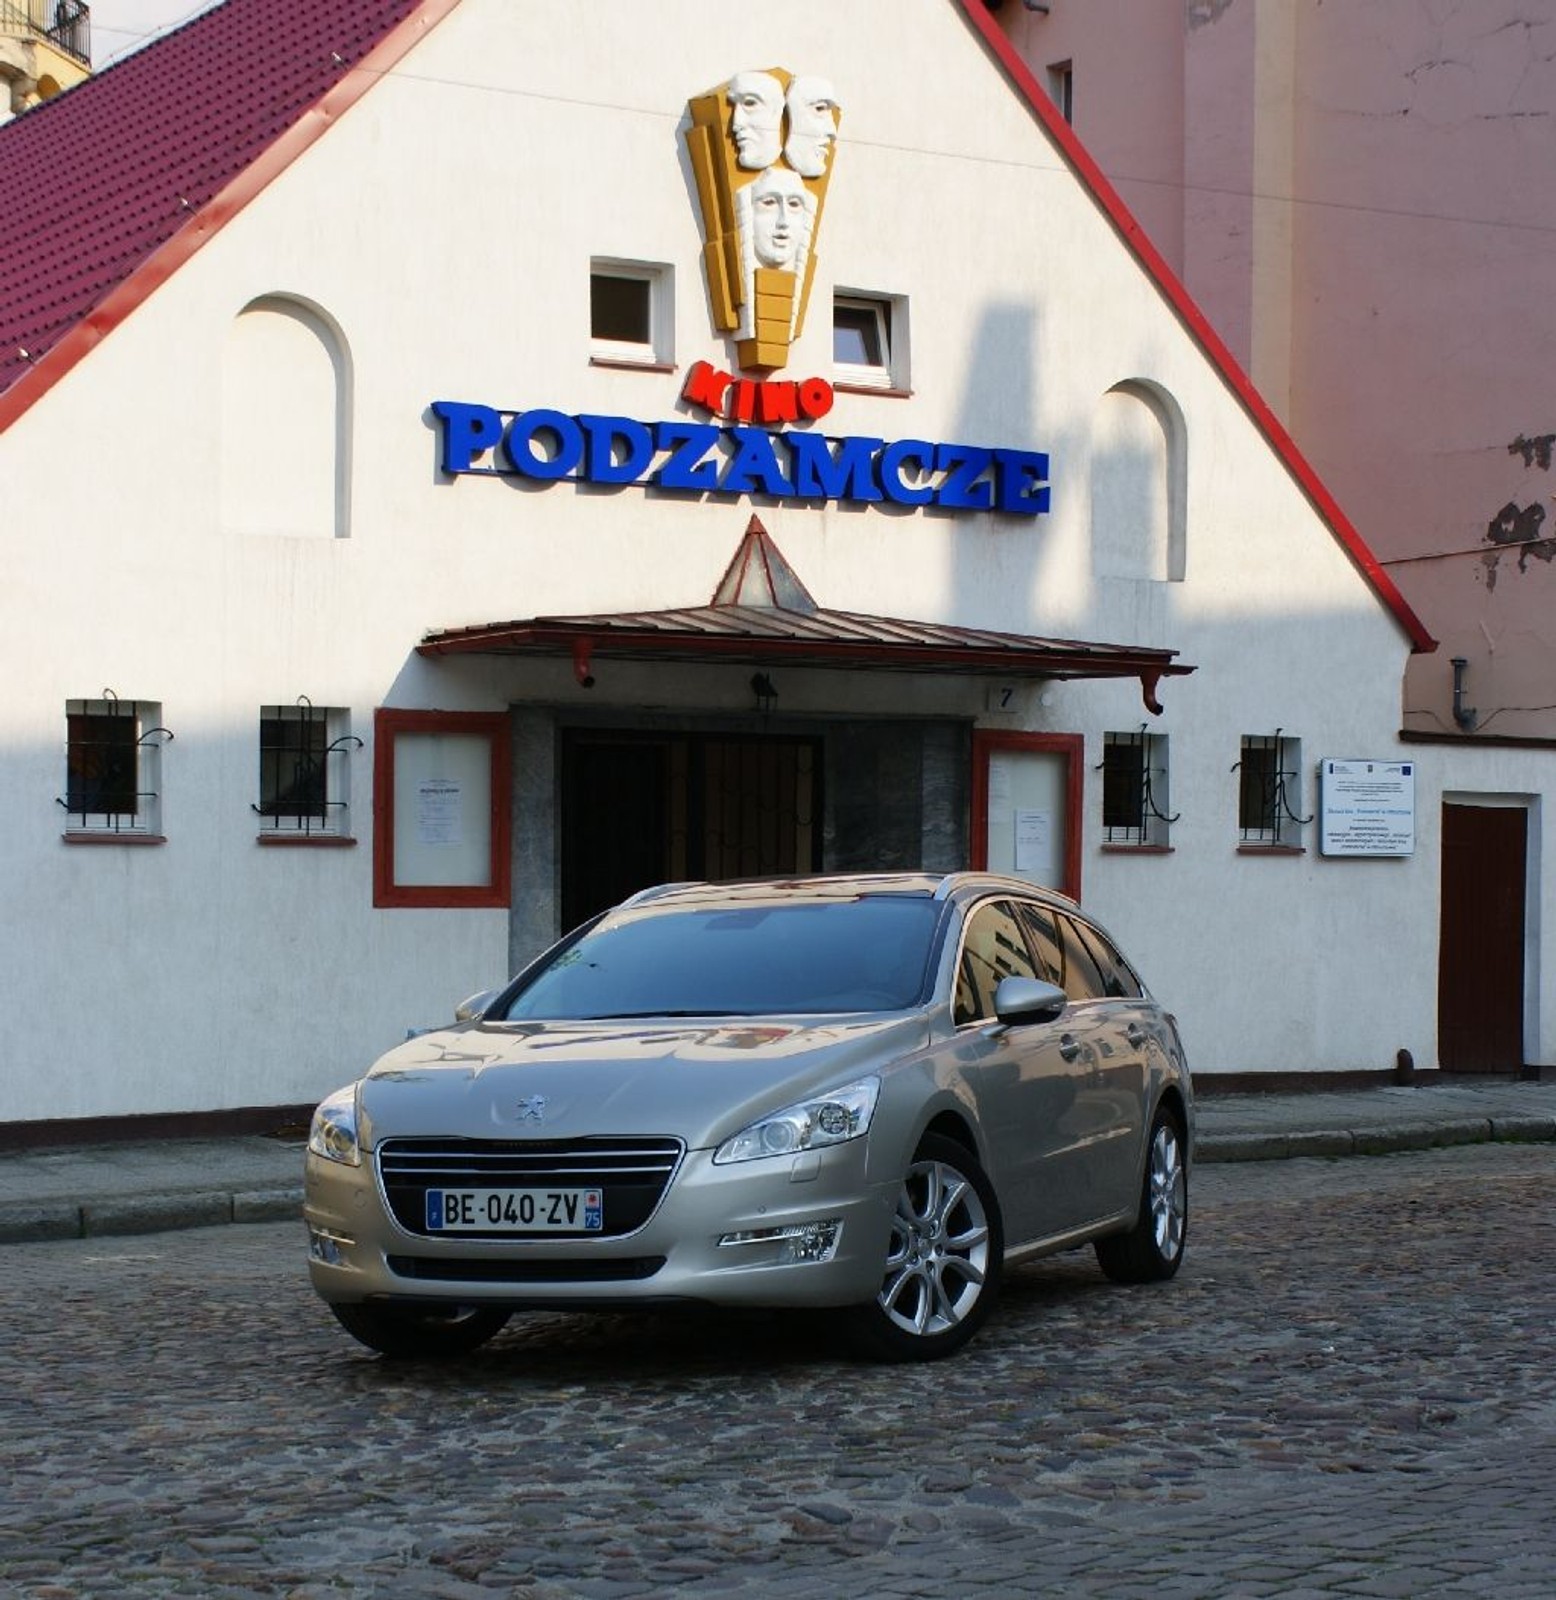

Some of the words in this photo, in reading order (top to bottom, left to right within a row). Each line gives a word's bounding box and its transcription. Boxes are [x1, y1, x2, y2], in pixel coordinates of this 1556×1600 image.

[683, 361, 834, 422] KINO
[431, 401, 1050, 514] PODZAMCZE
[1001, 688, 1012, 707] 7
[444, 1193, 579, 1224] BE-040-ZV
[586, 1212, 600, 1227] 75
